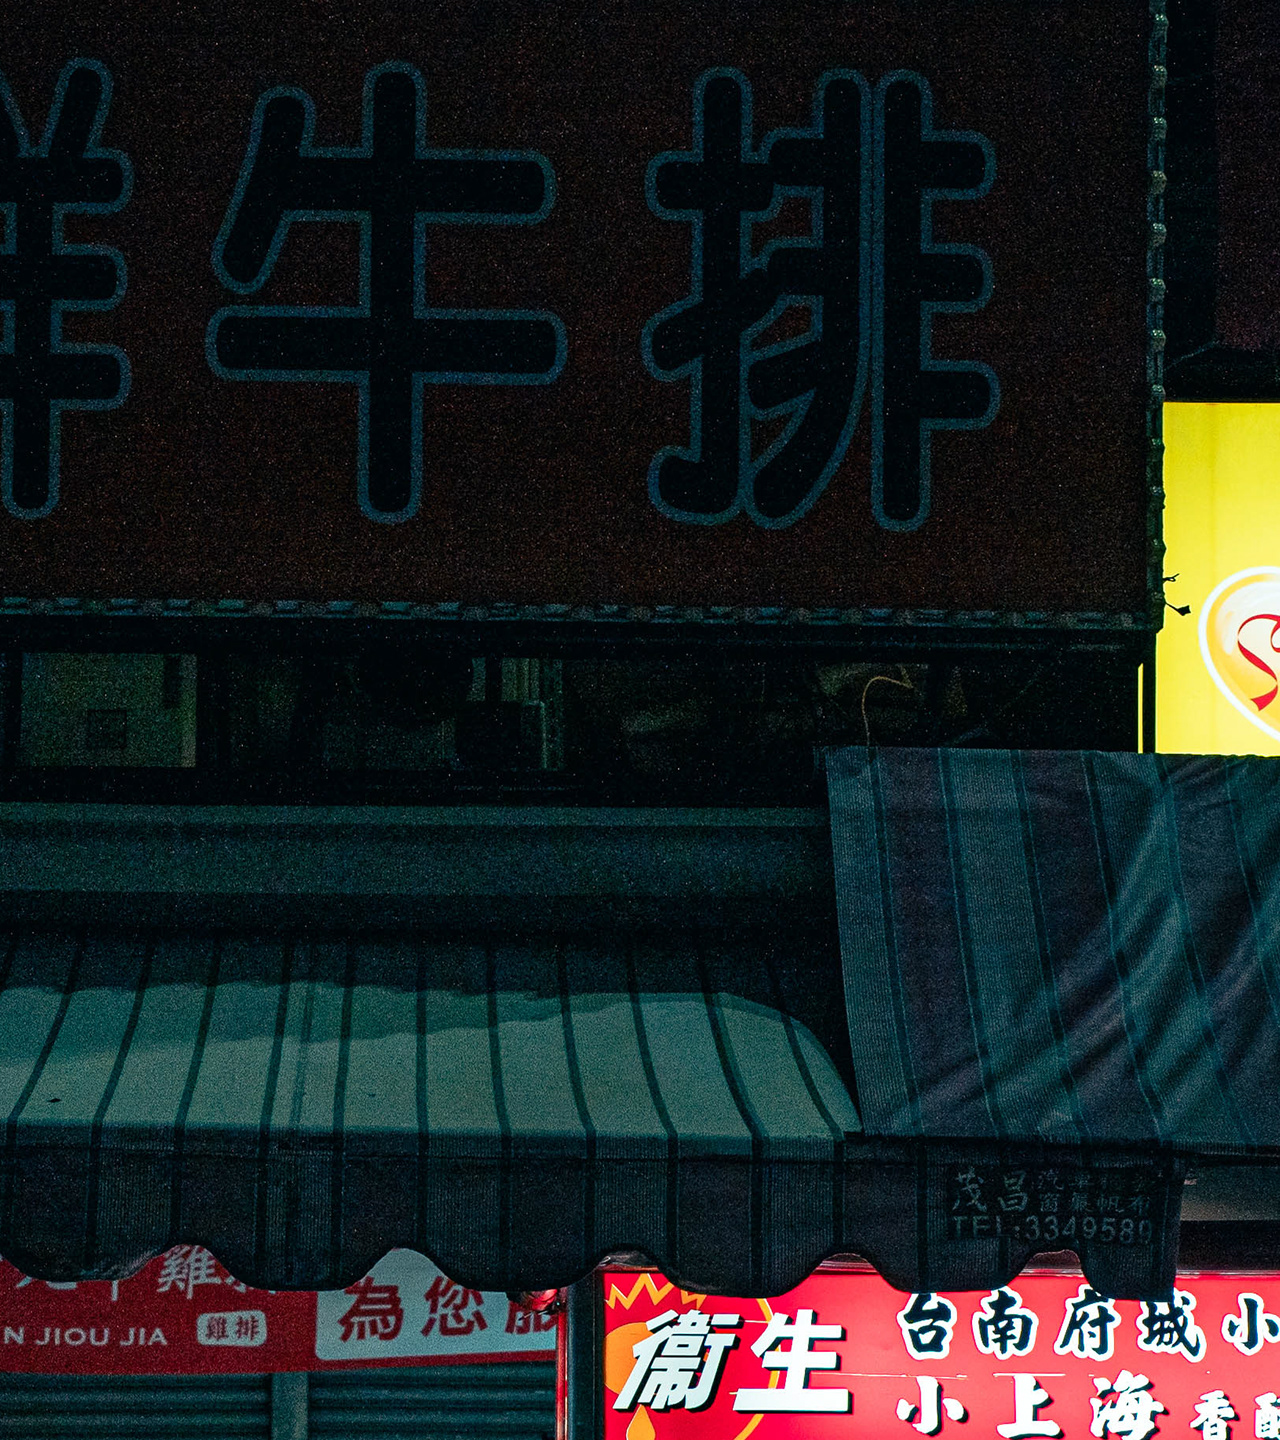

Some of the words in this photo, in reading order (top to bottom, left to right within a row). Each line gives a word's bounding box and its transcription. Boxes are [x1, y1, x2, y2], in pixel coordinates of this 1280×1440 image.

[34, 1325, 110, 1346] JIOU
[121, 1326, 169, 1347] JIA
[203, 1315, 262, 1341] 雞排
